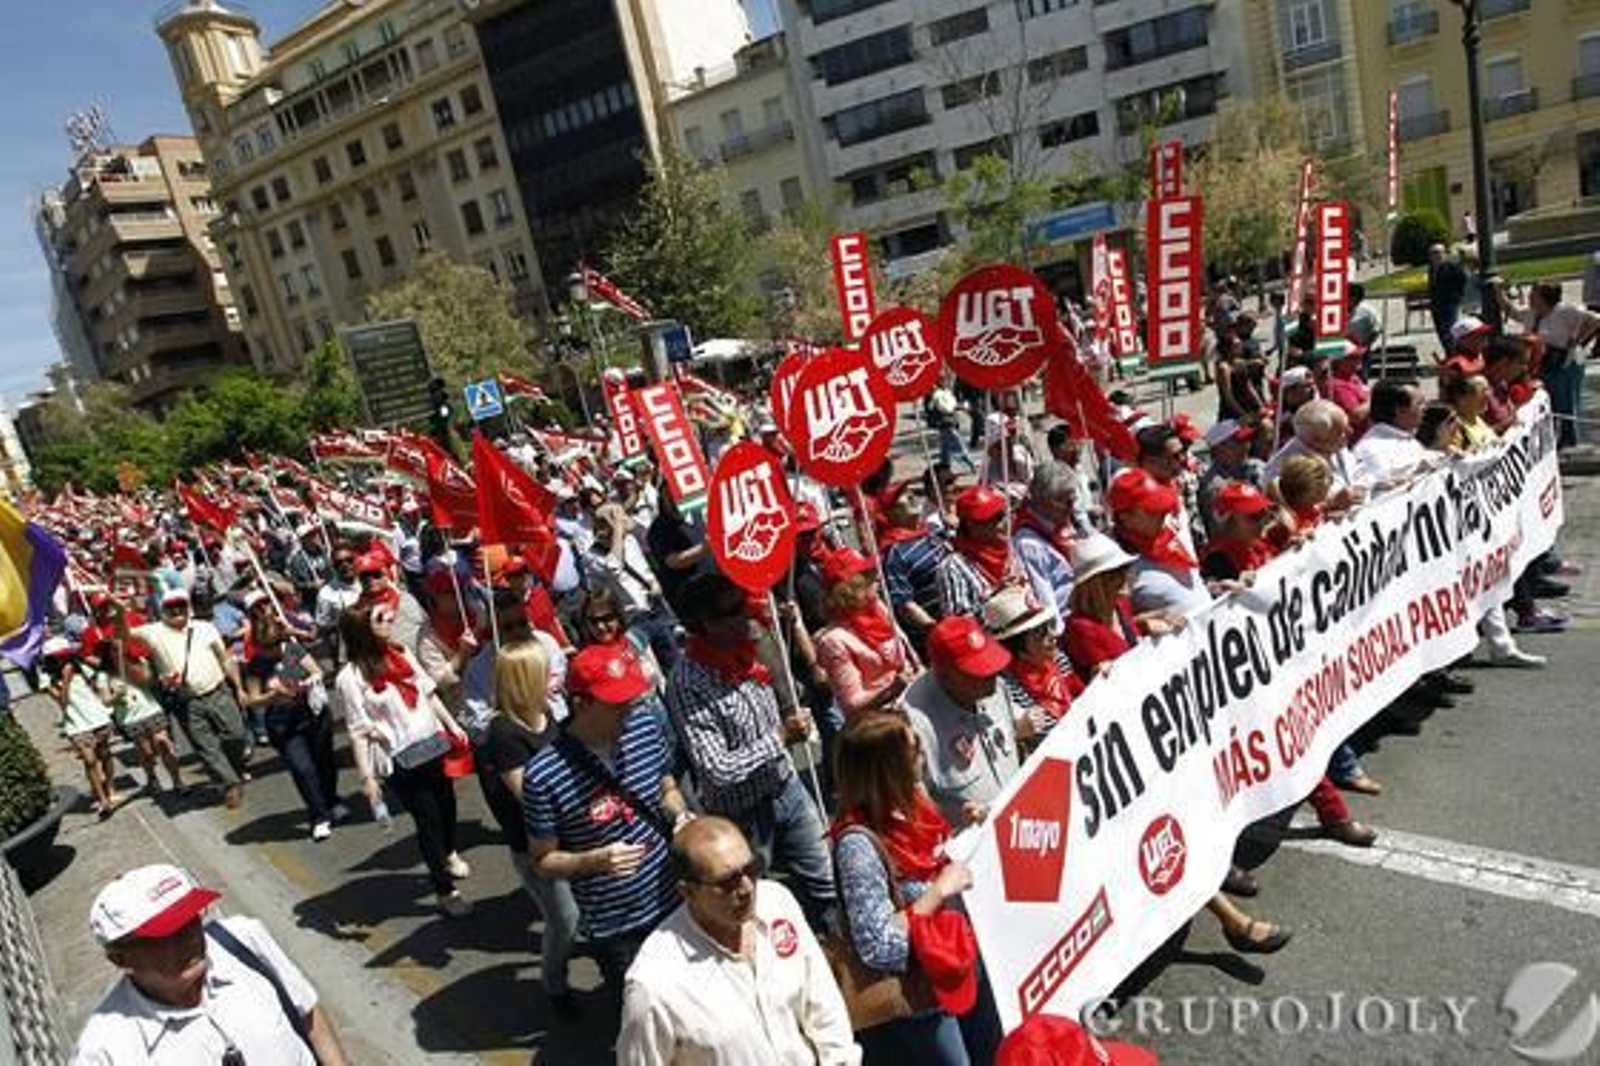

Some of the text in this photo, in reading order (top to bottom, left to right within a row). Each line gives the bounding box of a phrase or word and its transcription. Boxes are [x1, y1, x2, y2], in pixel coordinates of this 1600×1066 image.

[838, 238, 871, 338] CCOO
[956, 287, 1034, 338] UGT
[1108, 252, 1135, 352] CCOO
[1160, 201, 1190, 357] CCOO
[1322, 207, 1342, 334] CCOO
[870, 319, 926, 367] UGT
[613, 386, 641, 455] COO
[641, 387, 705, 496] CCOO
[804, 367, 876, 439] UGT
[720, 462, 777, 534] UGT
[1076, 716, 1145, 838] sin
[1268, 576, 1305, 666] de
[1213, 726, 1271, 809] MÁS
[1024, 919, 1091, 1014] CCOO
